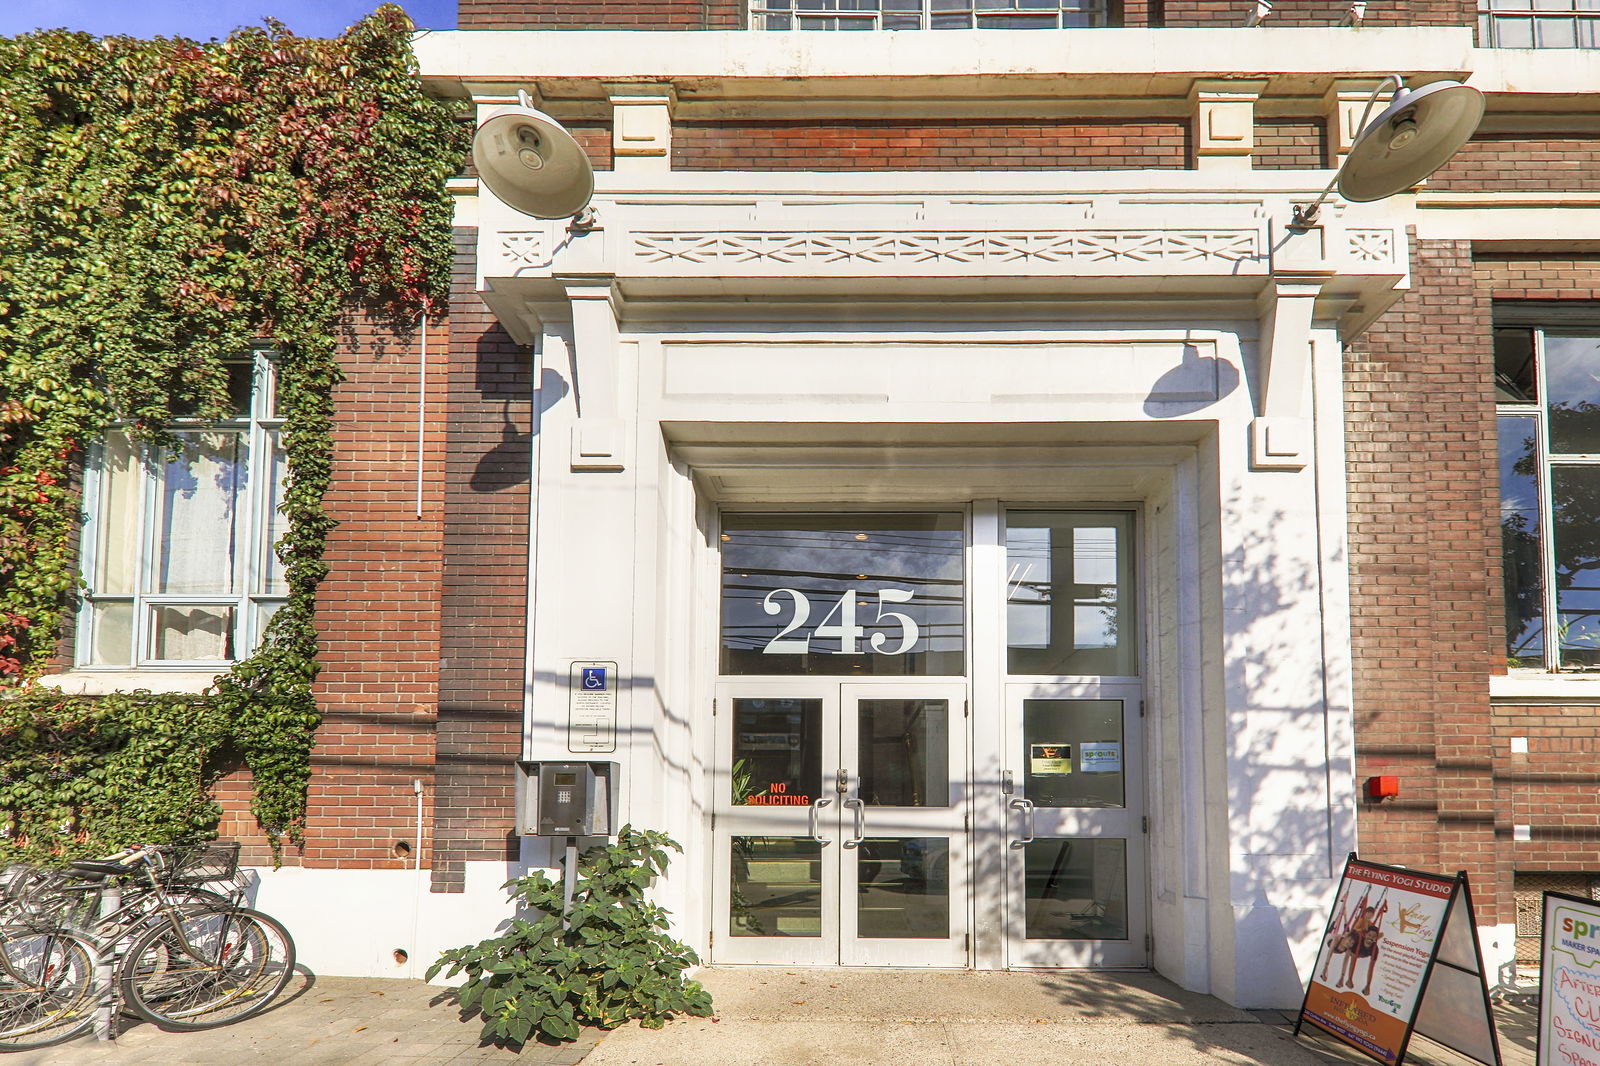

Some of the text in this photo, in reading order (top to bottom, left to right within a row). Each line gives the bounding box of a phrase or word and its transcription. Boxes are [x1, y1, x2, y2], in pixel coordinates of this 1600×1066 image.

[763, 588, 919, 655] 245
[770, 782, 786, 793] NO
[748, 795, 808, 805] SOLICITING
[1348, 866, 1451, 894] THE FLYING YOGI STUDIO
[1383, 938, 1430, 958] Suspension Yoga
[1562, 938, 1586, 951] MAKER
